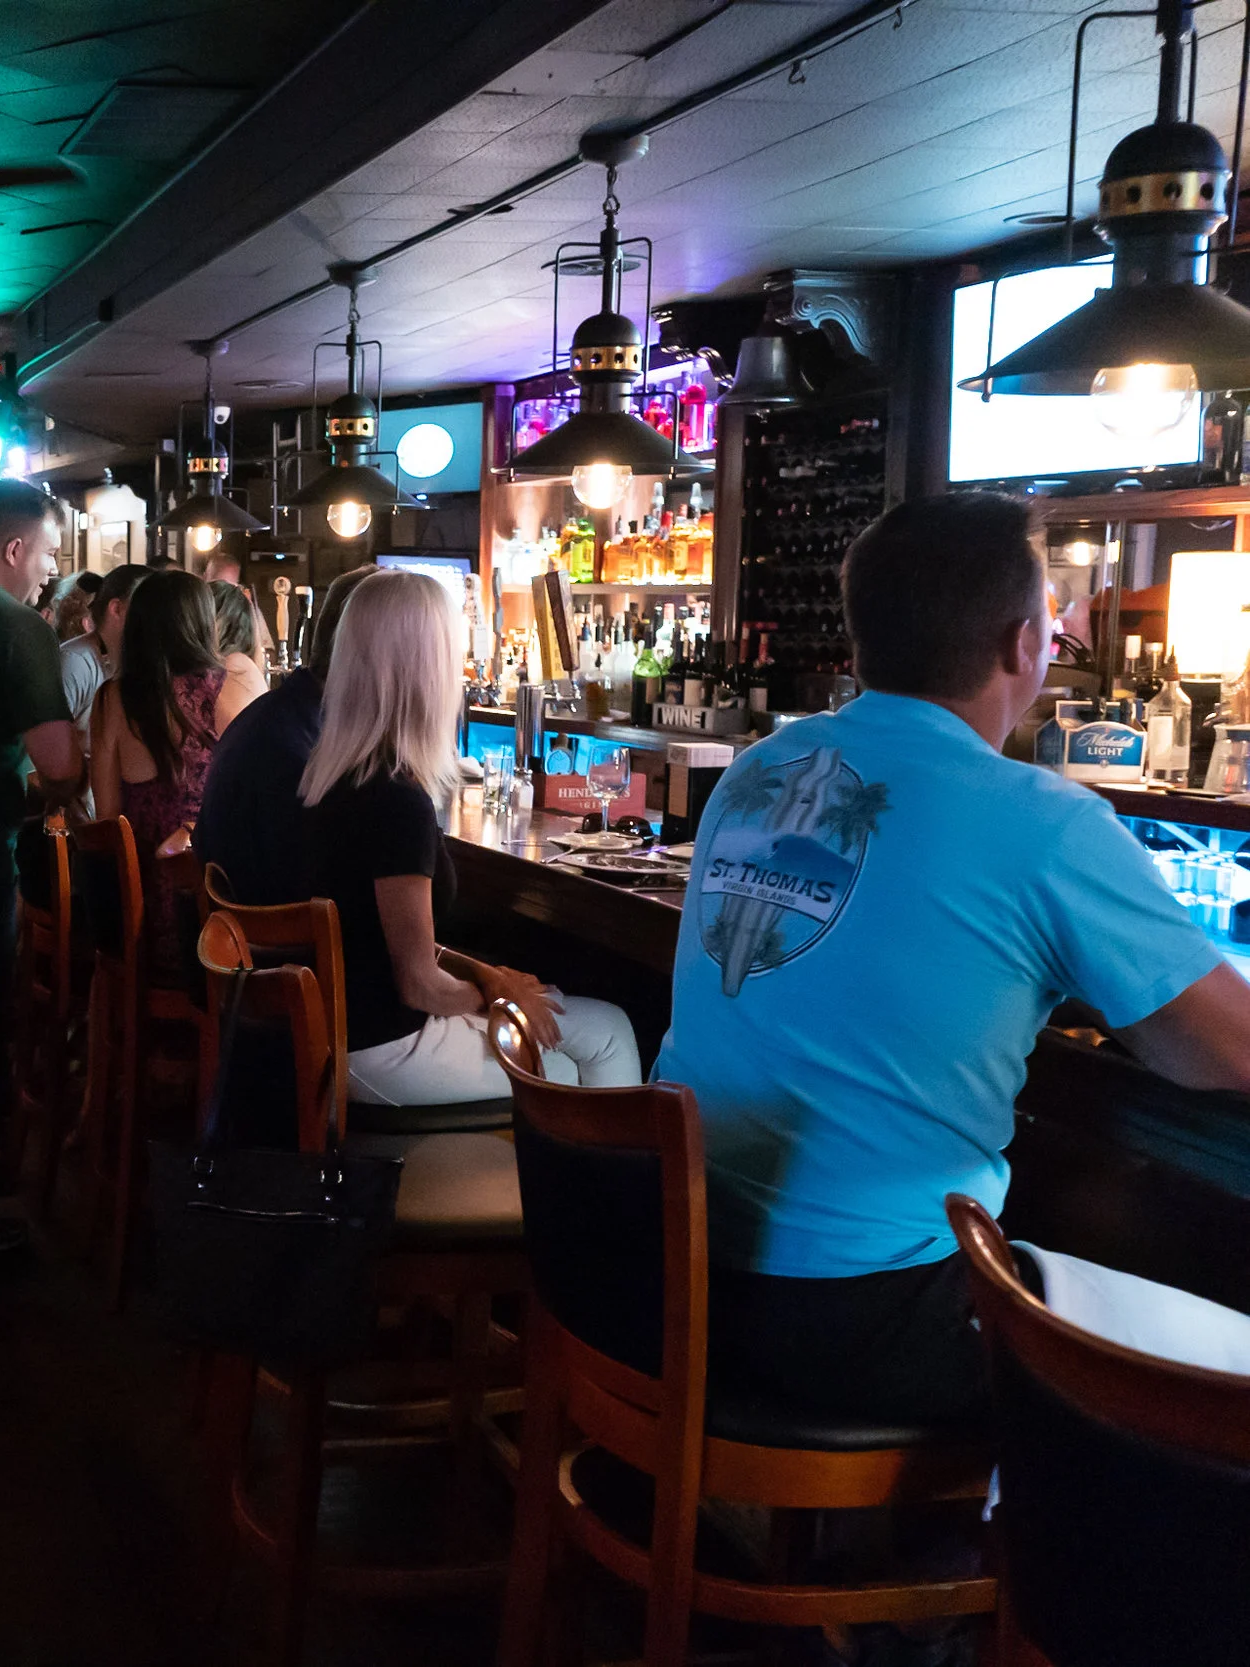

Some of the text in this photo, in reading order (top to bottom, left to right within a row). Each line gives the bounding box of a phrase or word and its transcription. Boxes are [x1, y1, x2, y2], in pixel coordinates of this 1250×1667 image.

[661, 706, 701, 729] WINE
[1087, 746, 1124, 757] LIGHT
[722, 880, 798, 906] VIRGIN ISLANDS
[740, 862, 837, 904] THOMAS
